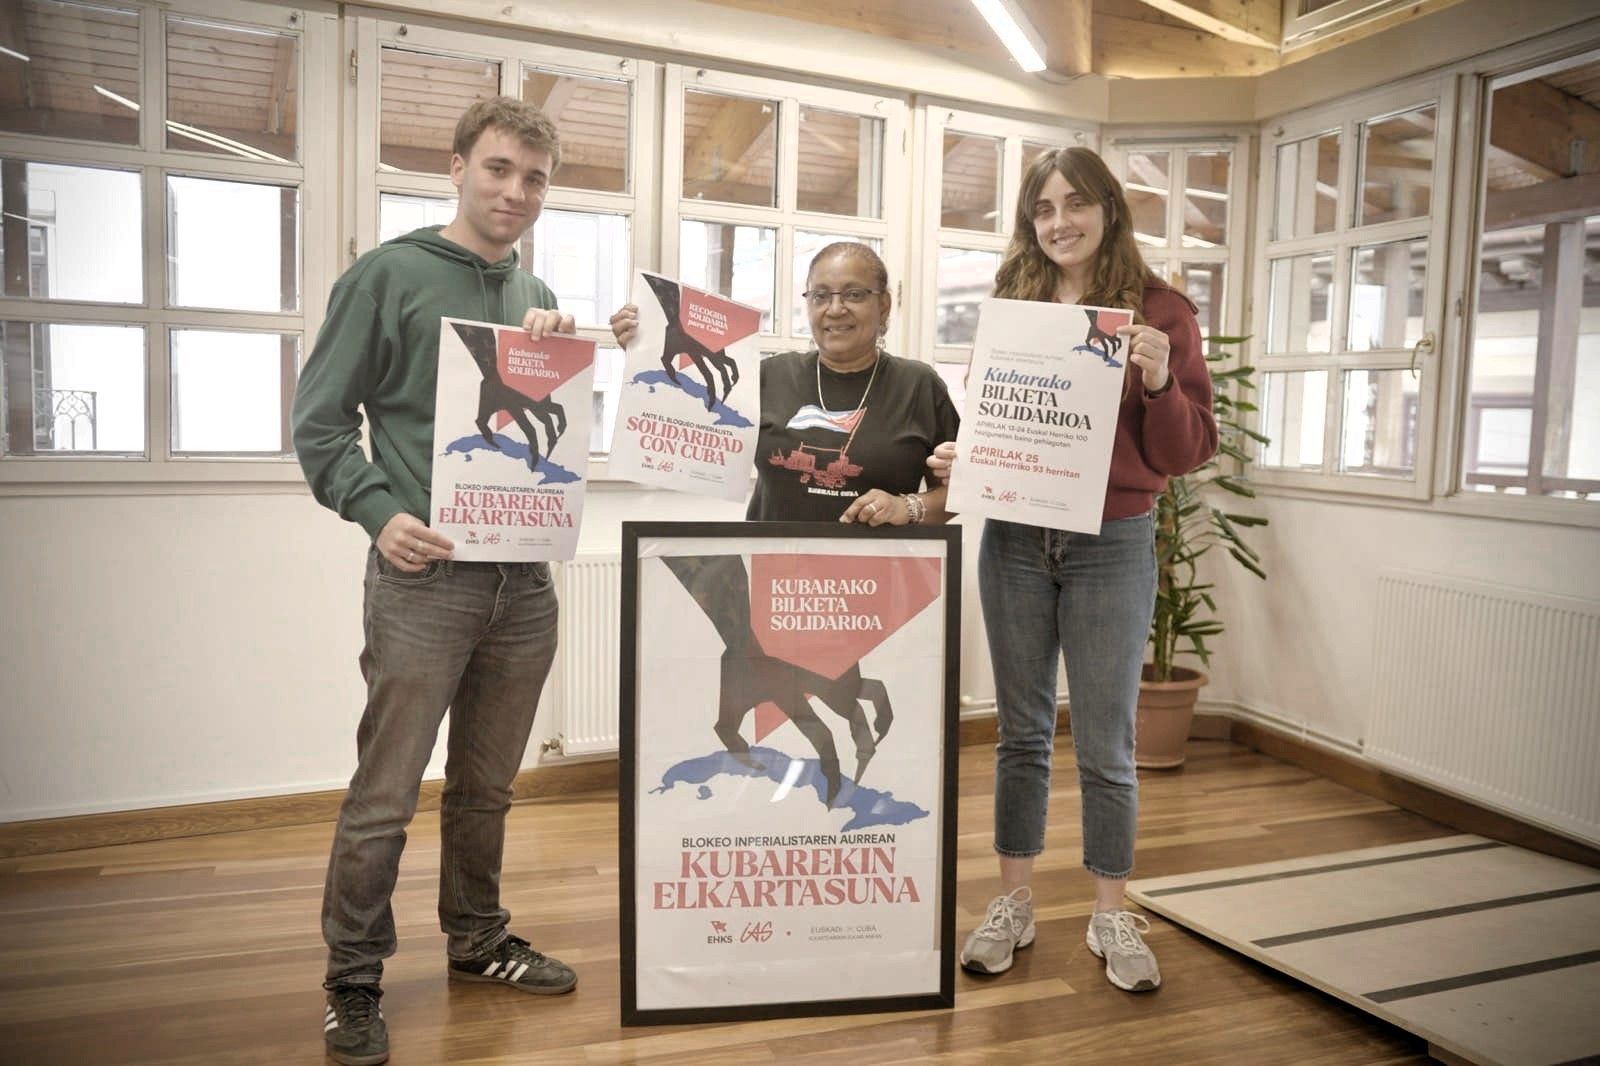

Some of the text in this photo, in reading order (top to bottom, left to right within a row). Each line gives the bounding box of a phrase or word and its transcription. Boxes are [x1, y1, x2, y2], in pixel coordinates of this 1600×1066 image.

[688, 311, 728, 331] SOLIDARIA
[689, 303, 727, 321] RECOGIDA
[706, 324, 725, 335] Cuba
[508, 356, 545, 369] BILKETA
[507, 365, 560, 380] SOLIDARIOA
[984, 367, 1072, 391] Kubarako
[982, 384, 1058, 407] BILKETA
[641, 411, 657, 420] ANTE
[666, 417, 695, 429] BLOQUEO
[696, 424, 733, 437] IMPERIALISTA
[978, 401, 1092, 430] SOLIDARIOA
[626, 416, 744, 454] SOLIDARIDAD
[1027, 427, 1048, 436] Euskal
[1075, 434, 1088, 442] 100
[640, 435, 725, 466] CON CUBA
[970, 445, 1039, 463] APIRILAK 25
[970, 456, 1080, 479] Euskal Herriko 93 herritan
[455, 483, 564, 495] BLOKEO INPERIALISTAREN AURREAN
[454, 491, 565, 512] KUBAREKIN
[439, 507, 573, 528] ELKARTASUNA
[771, 579, 877, 595] KUBARAKO
[771, 597, 848, 612] BILKETA
[770, 614, 883, 631] SOLIDARIOA
[681, 833, 895, 848] BLOKEO INPERIALISTAREN AURREAN
[680, 847, 896, 878] KUBAREKIN
[653, 876, 920, 910] ELKARTASUNA
[855, 924, 877, 933] CUBA
[707, 935, 733, 944] EHKS
